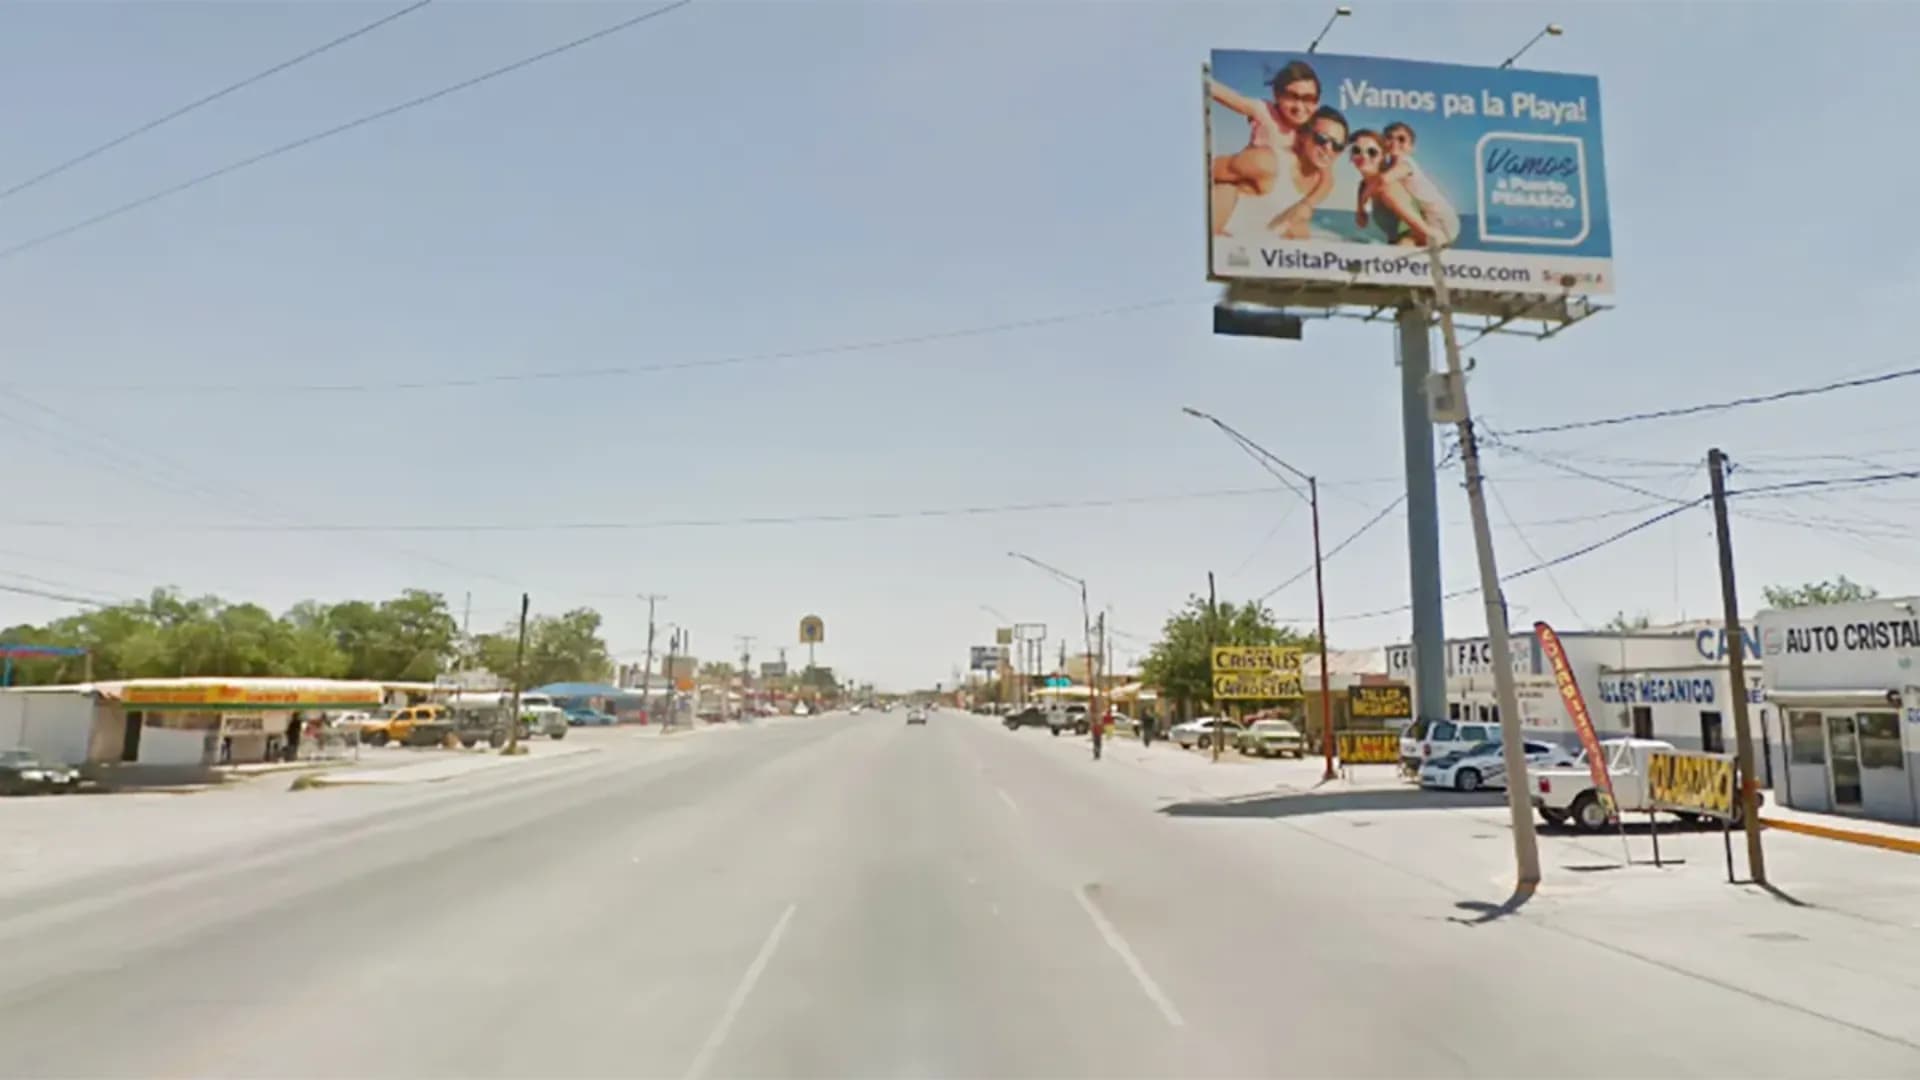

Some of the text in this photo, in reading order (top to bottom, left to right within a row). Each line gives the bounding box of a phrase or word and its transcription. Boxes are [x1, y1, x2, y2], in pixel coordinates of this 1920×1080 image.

[1339, 78, 1587, 126] ¡Vamos pa la Playa!
[1486, 148, 1577, 177] Vamos
[1786, 625, 1839, 654] AUTO
[1216, 649, 1300, 670] CRISTALES
[1640, 678, 1715, 703] MECANICO
